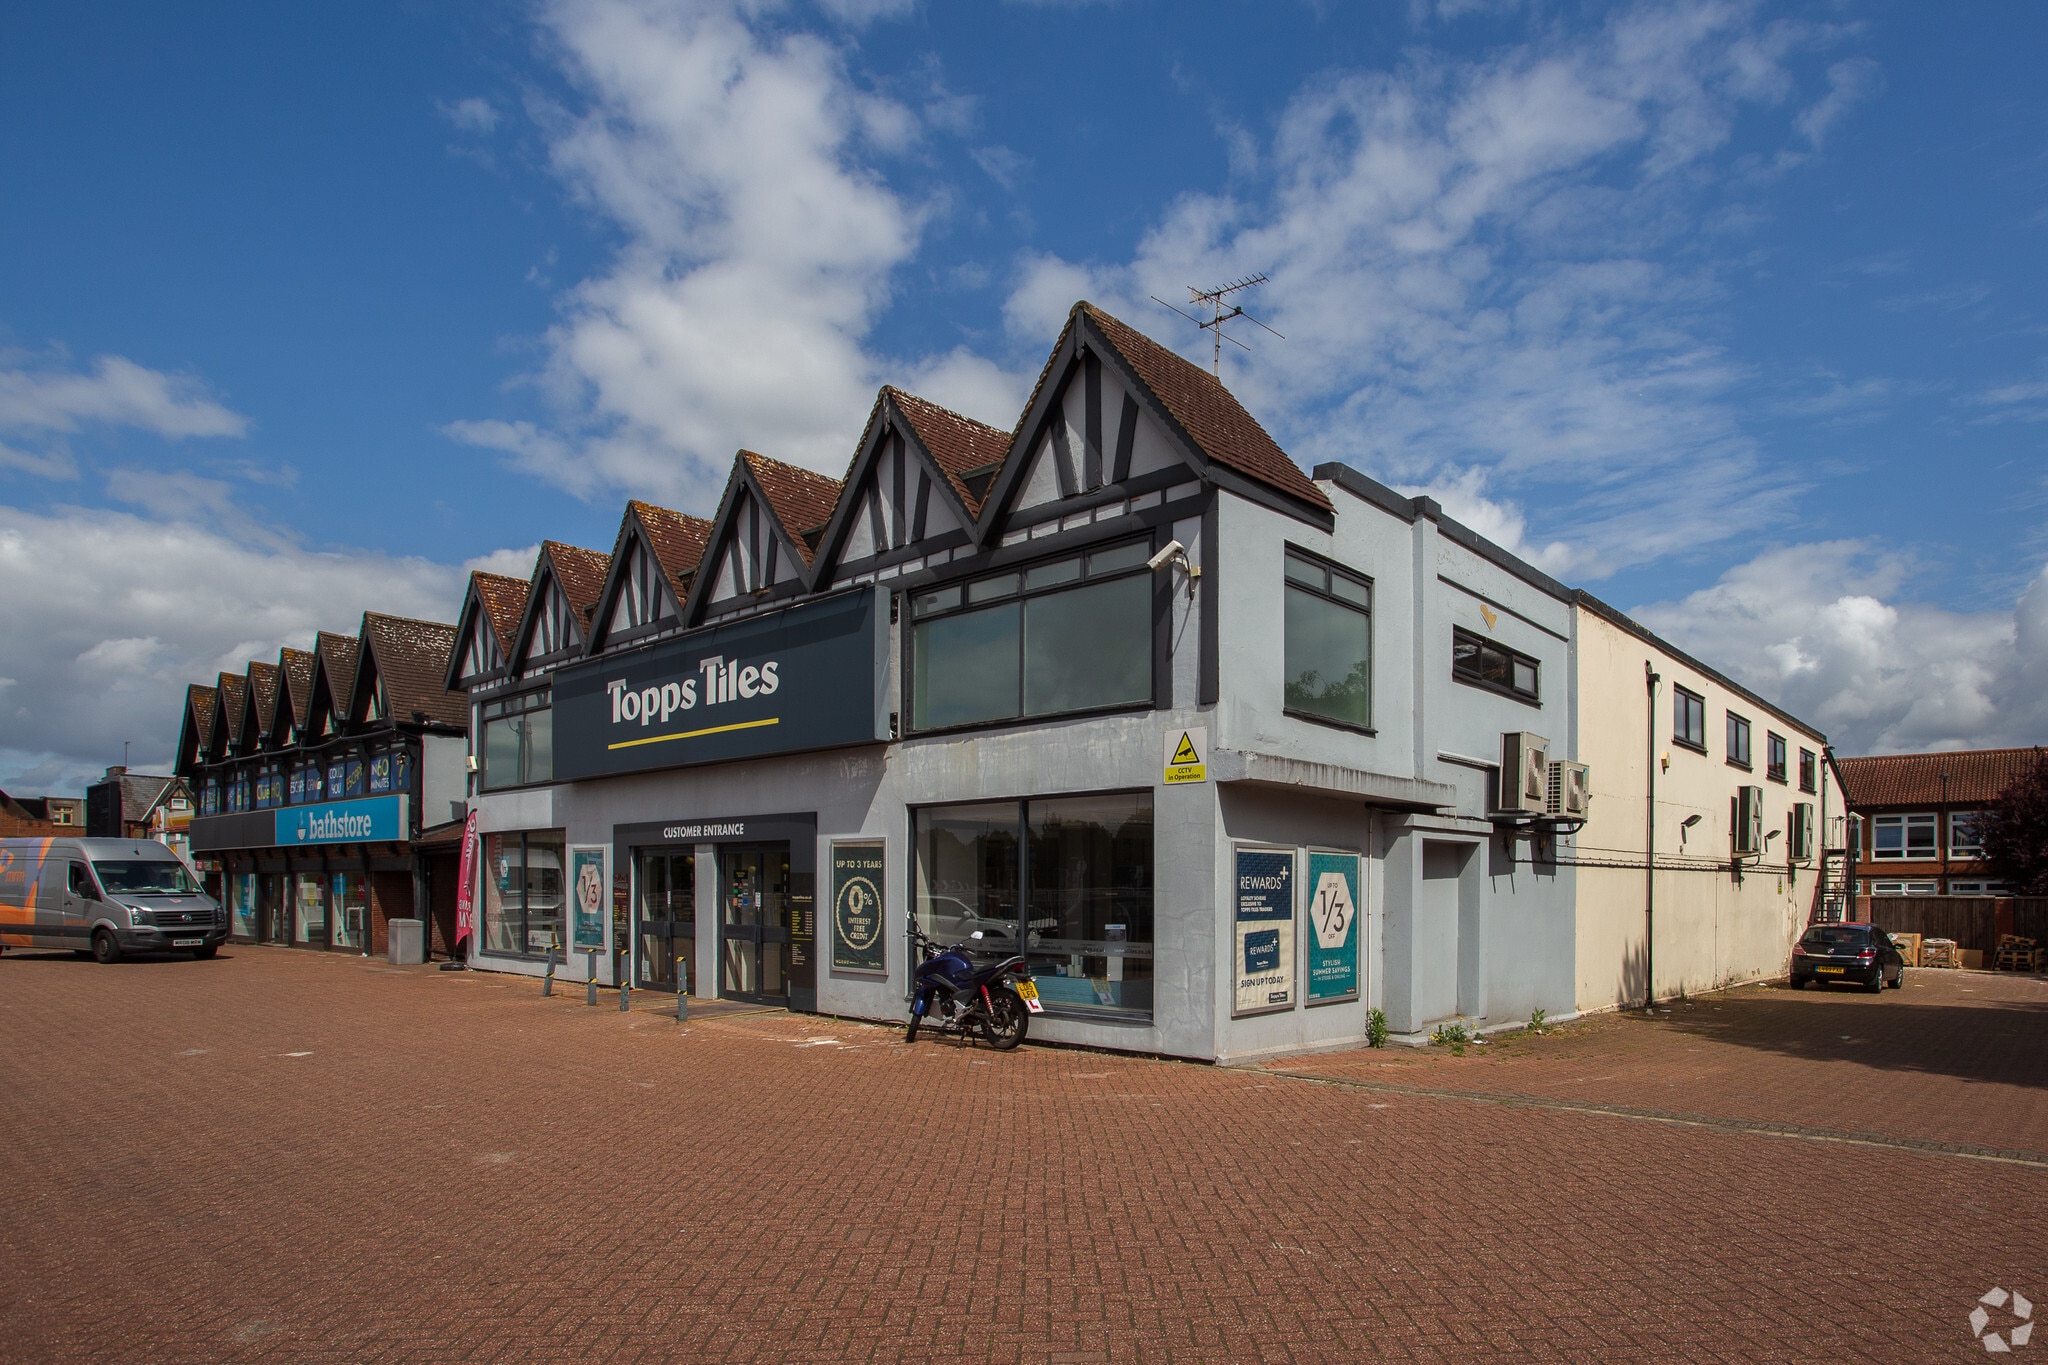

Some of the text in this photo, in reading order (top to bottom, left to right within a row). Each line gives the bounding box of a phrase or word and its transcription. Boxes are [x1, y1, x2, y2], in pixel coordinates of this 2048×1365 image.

[607, 655, 780, 726] Topps Tiles
[329, 766, 344, 780] COULD
[377, 757, 389, 777] 60
[346, 763, 363, 792] ESCAPE
[370, 777, 390, 790] MINUTES
[256, 784, 270, 801] Clue
[289, 780, 305, 794] ESCAPE
[308, 809, 372, 840] bathstore
[663, 823, 744, 839] CUSTOMER ENTRANCE
[836, 861, 846, 869] UP
[863, 860, 882, 868] YEARS
[1320, 890, 1344, 933] 1/3
[847, 917, 871, 925] INTEREST
[853, 925, 866, 933] FREE
[850, 932, 869, 940] CREDIT
[1322, 959, 1341, 967] STYLISH
[1313, 968, 1331, 976] SUMMER
[1241, 976, 1284, 988] SIGN UP TODAY
[1028, 1000, 1039, 1009] L
